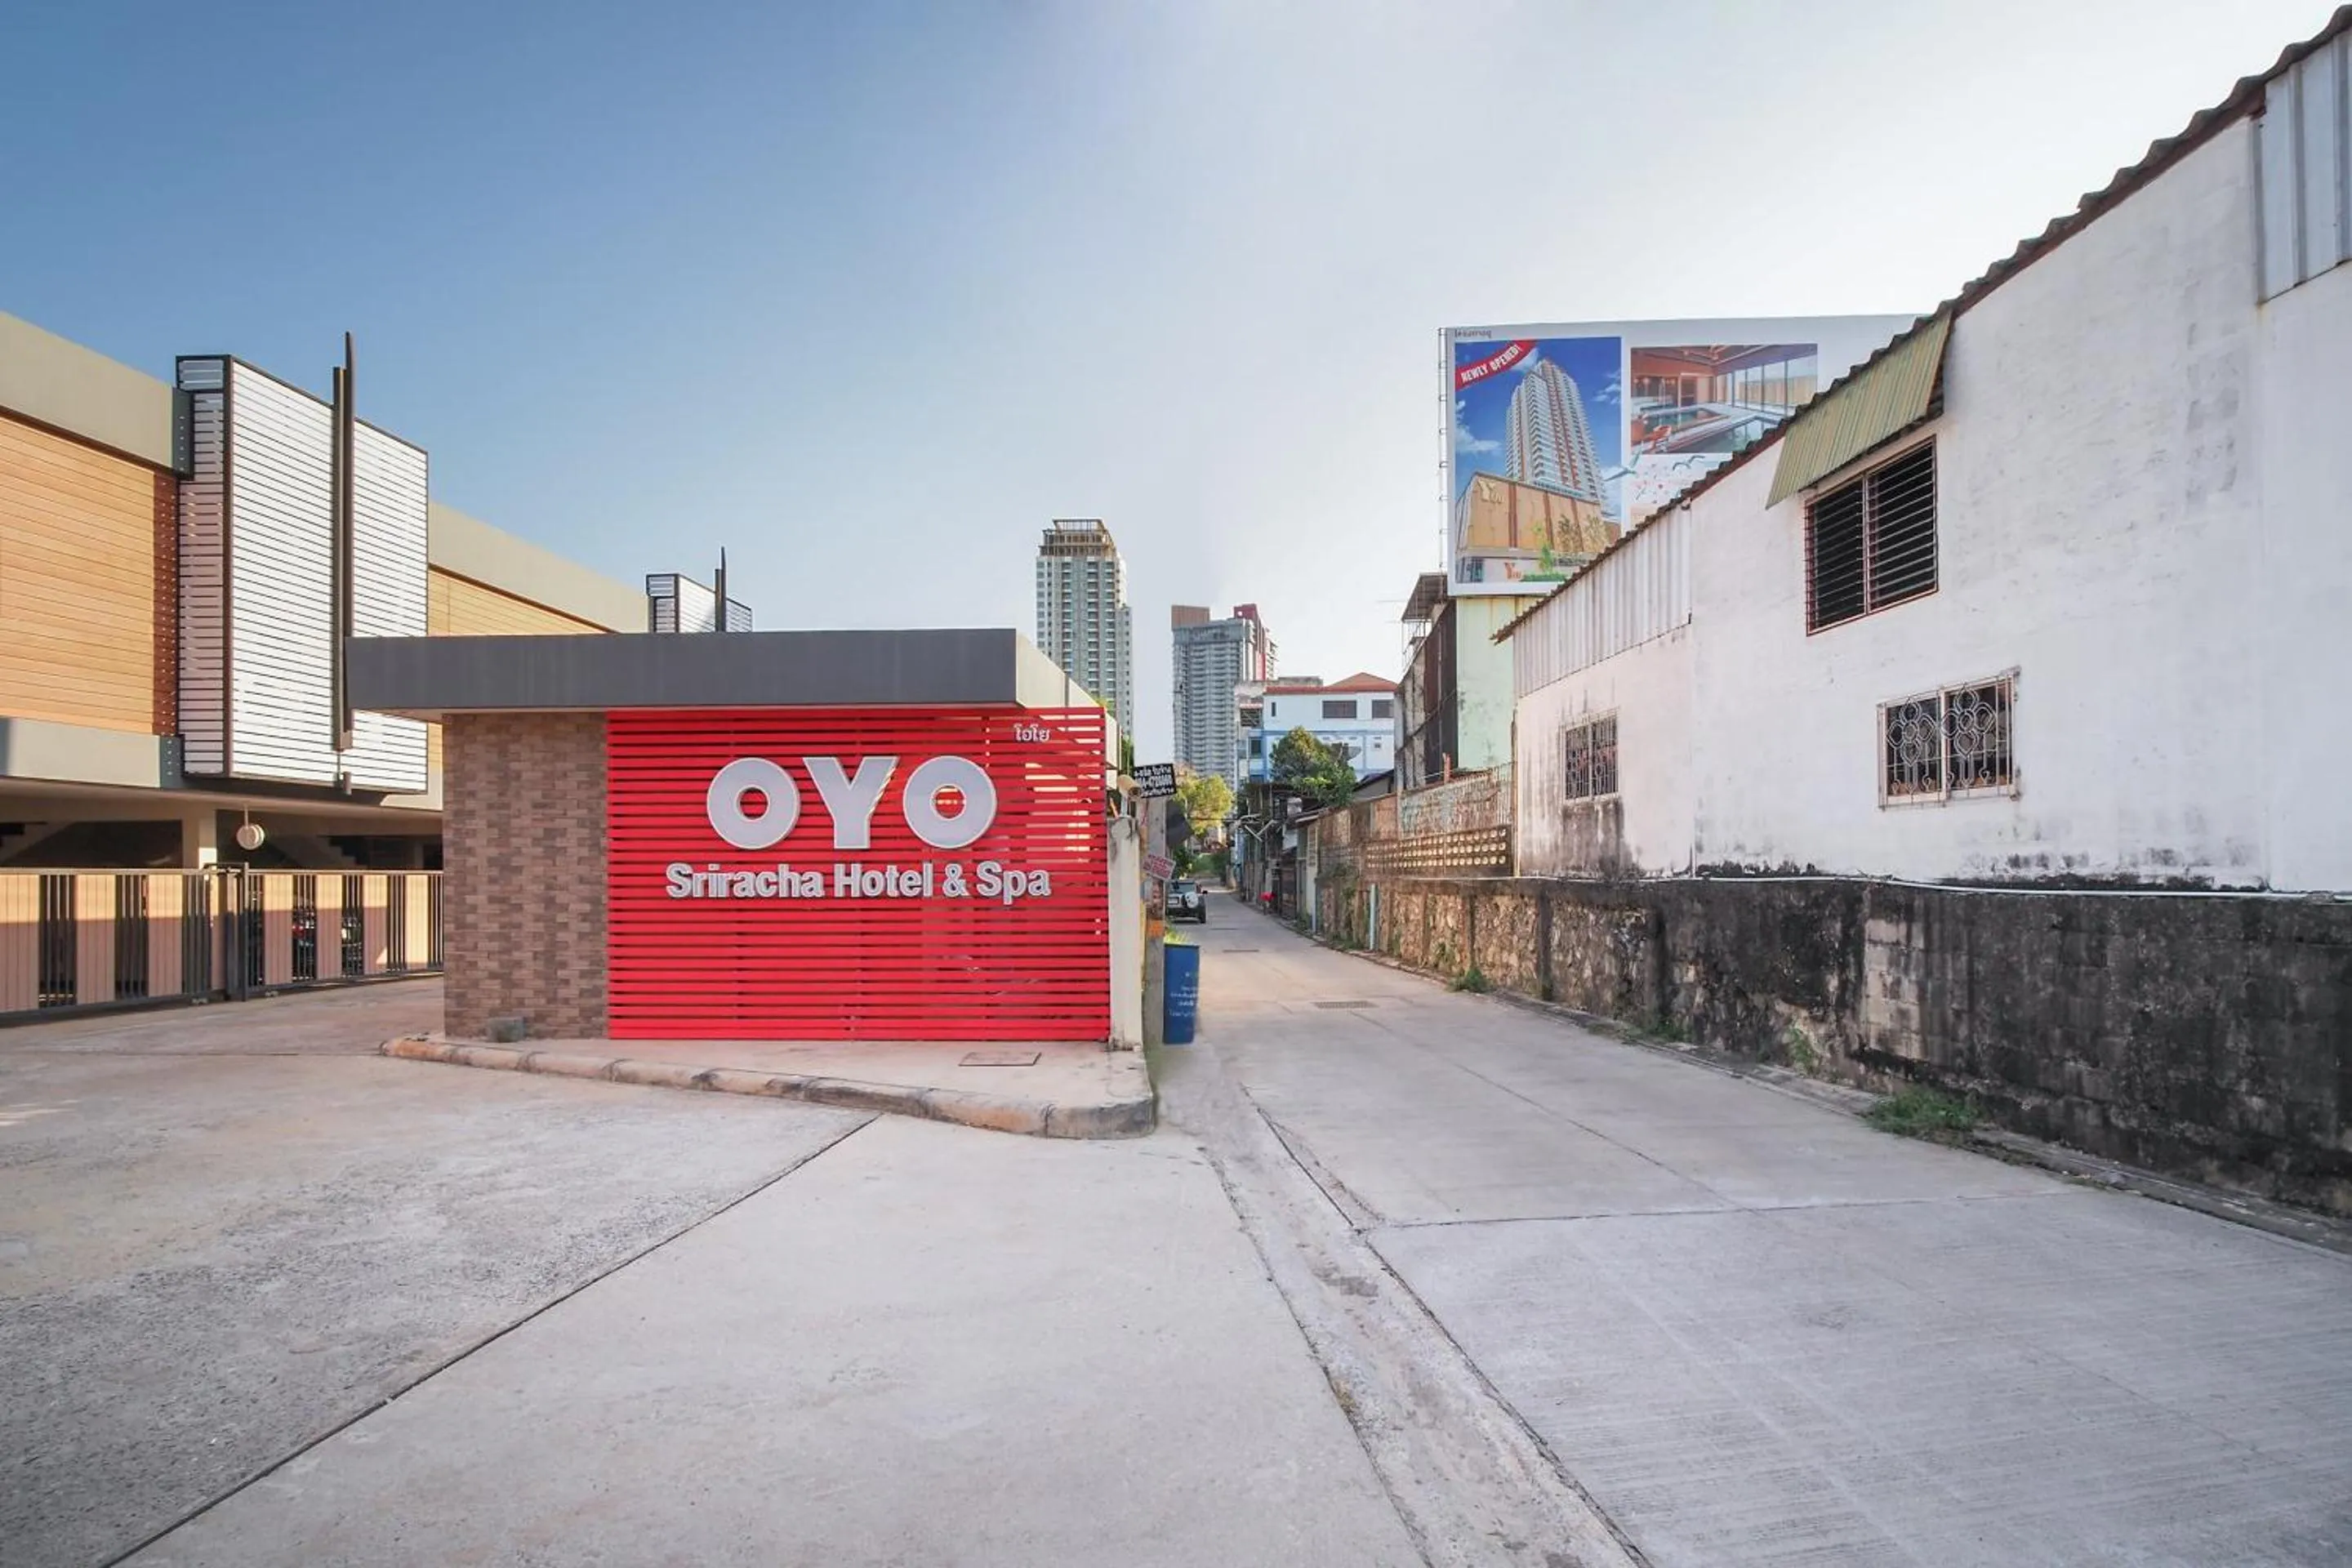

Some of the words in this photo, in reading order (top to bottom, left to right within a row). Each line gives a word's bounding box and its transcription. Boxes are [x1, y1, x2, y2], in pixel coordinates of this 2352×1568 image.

[1461, 363, 1487, 383] NEWLY
[1490, 344, 1523, 371] OPENED!
[1013, 723, 1050, 742] โอโย
[706, 755, 997, 849] OYO
[666, 862, 825, 898] Sriracha
[834, 862, 933, 898] Hotel
[942, 863, 969, 898] &
[977, 860, 1052, 905] Spa
